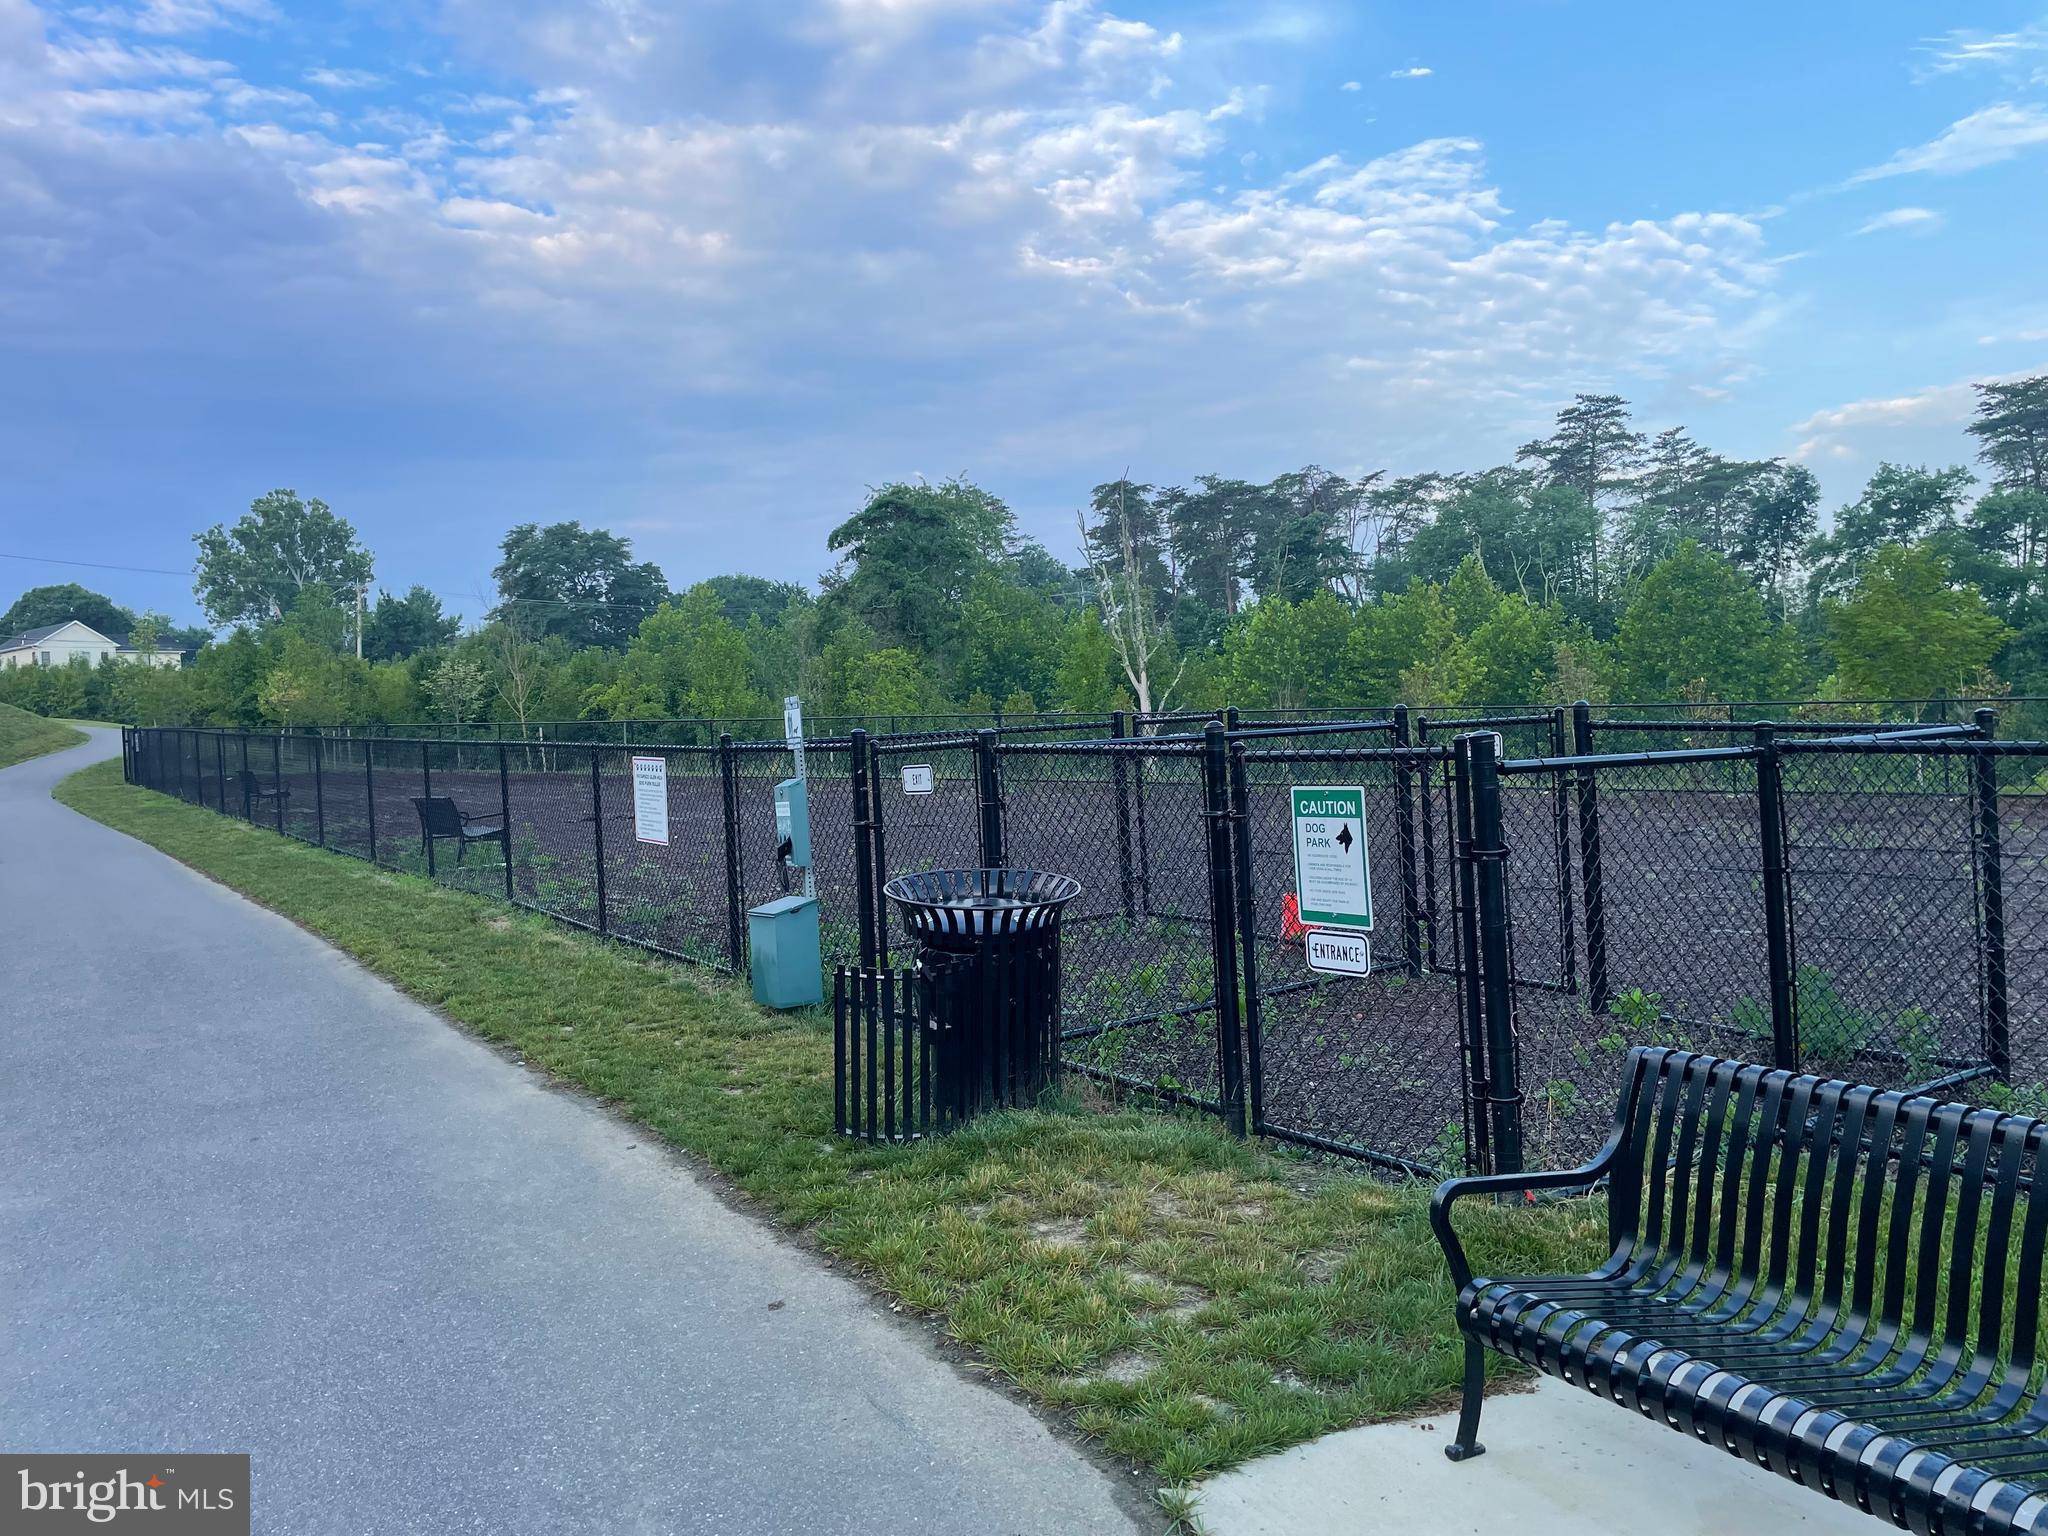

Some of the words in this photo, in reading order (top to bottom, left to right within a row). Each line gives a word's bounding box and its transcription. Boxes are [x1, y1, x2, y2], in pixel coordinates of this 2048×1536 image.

[912, 774, 922, 785] EXIT
[1300, 800, 1356, 815] CAUTION
[1305, 823, 1326, 833] DOG
[1306, 837, 1331, 848] PARK
[1314, 943, 1360, 963] ENTRANCE
